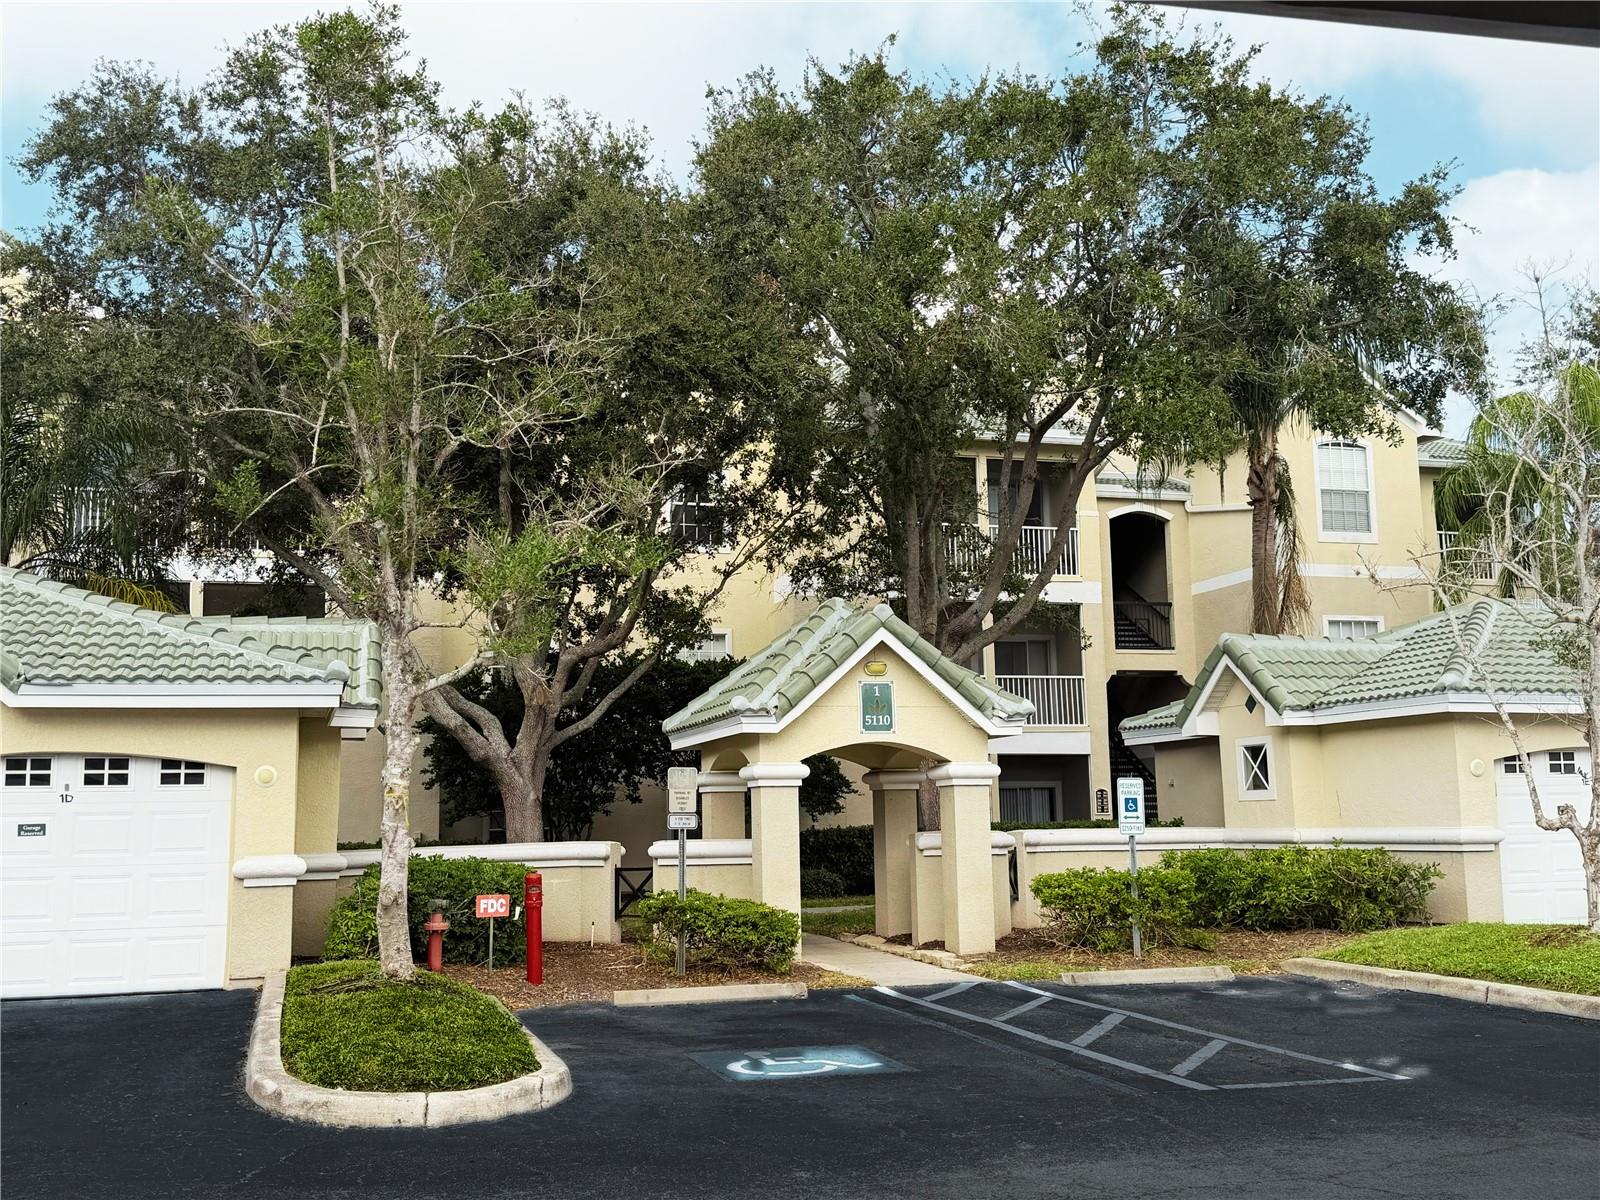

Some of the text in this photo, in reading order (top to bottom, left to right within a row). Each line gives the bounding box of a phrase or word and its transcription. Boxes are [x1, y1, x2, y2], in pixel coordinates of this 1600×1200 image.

[873, 686, 880, 697] 1
[865, 715, 891, 726] 5110
[59, 794, 74, 804] 1D
[480, 898, 506, 914] FDC
